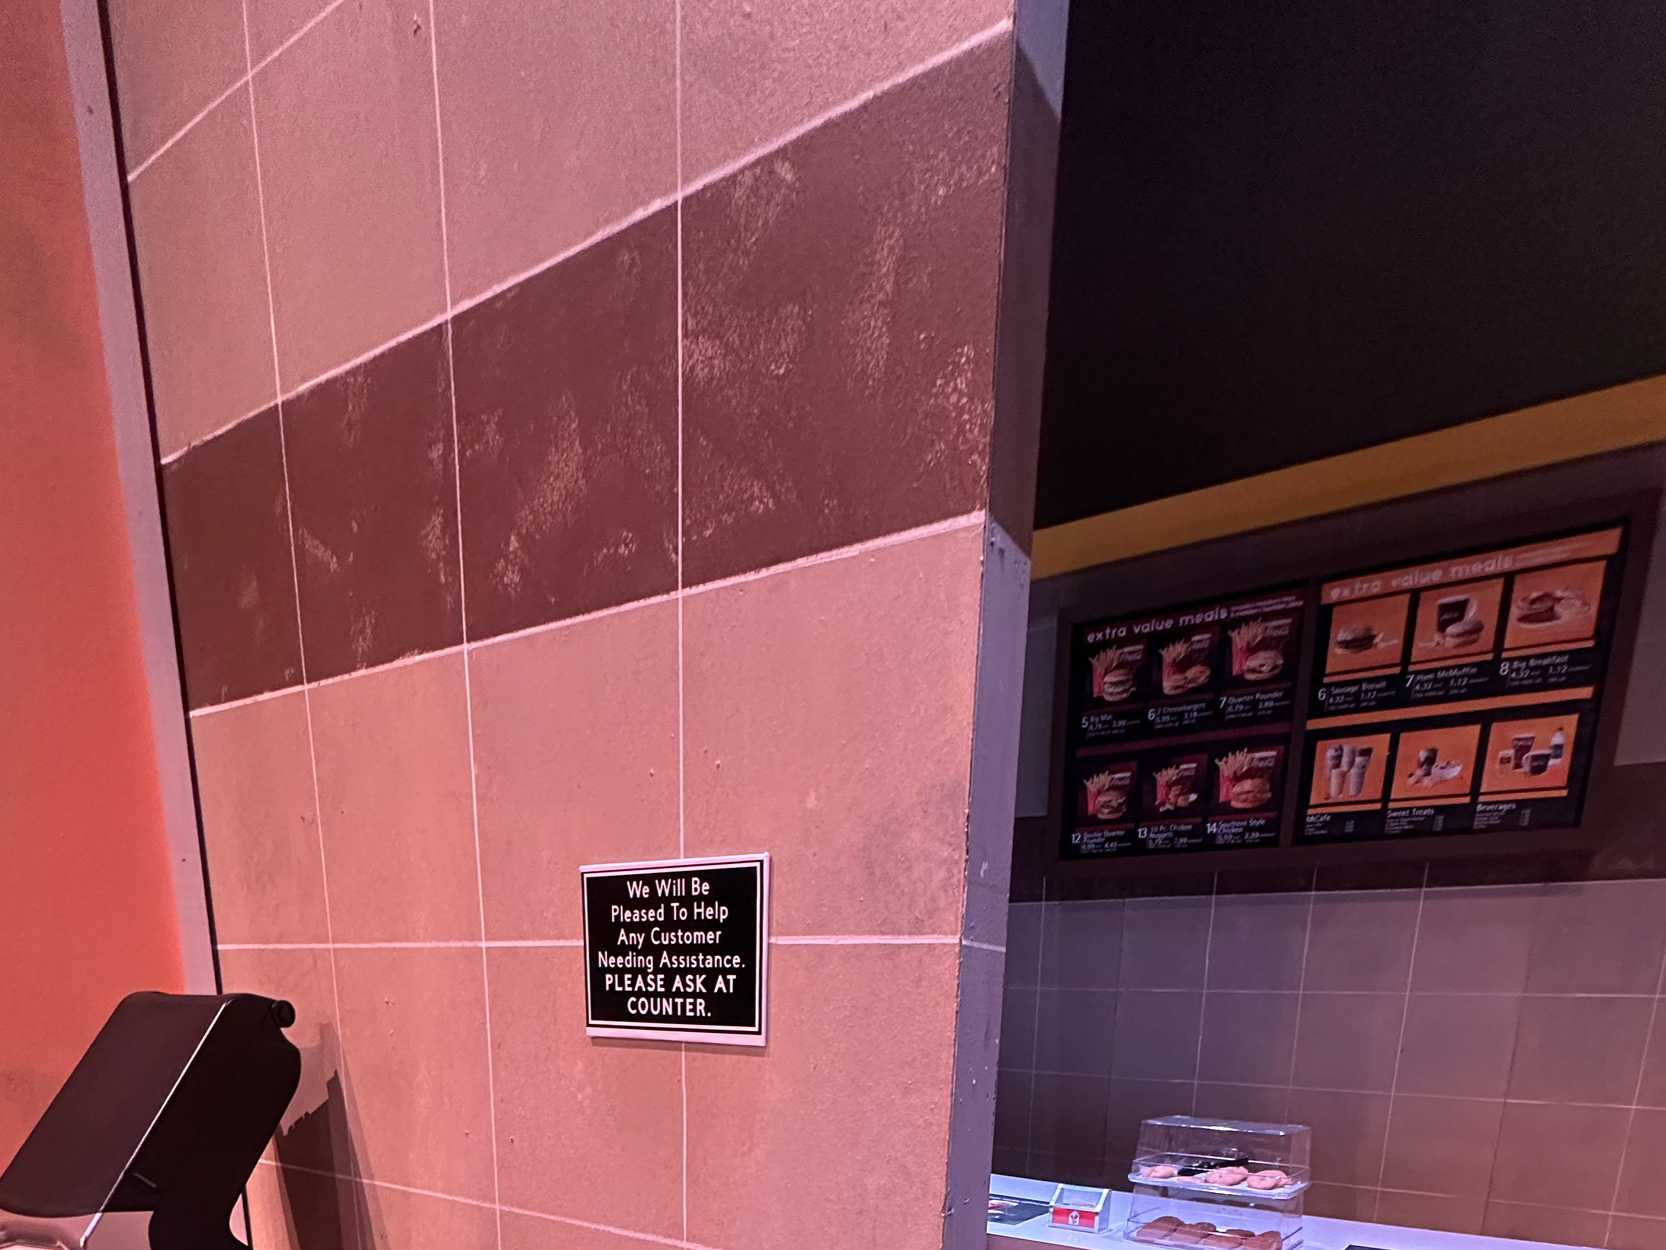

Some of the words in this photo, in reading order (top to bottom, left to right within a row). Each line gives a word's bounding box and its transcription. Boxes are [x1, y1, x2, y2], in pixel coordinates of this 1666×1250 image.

[1330, 579, 1381, 599] extra
[1391, 568, 1443, 588] value
[1450, 554, 1514, 578] meals
[1086, 627, 1127, 644] extra
[1132, 618, 1174, 635] value
[1178, 606, 1228, 627] meals
[1498, 661, 1510, 676] 8
[1405, 674, 1415, 688] 7
[1317, 688, 1327, 701] 6
[1219, 696, 1227, 709] 7
[1147, 708, 1156, 721] 6
[1081, 716, 1089, 729] 5
[1386, 808, 1410, 819] Sweet
[1411, 807, 1435, 816] Treats
[1476, 802, 1517, 812] Beverages
[1137, 827, 1148, 839] 13
[1205, 822, 1218, 834] 14
[1071, 833, 1082, 844] 12
[627, 880, 650, 899] We
[655, 878, 686, 897] Will
[691, 877, 710, 896] Be
[611, 903, 665, 923] Pleased
[670, 902, 688, 921] To
[693, 901, 729, 923] Help
[617, 928, 645, 949] Any
[650, 927, 722, 945] Customer
[598, 951, 654, 972] Needing
[659, 950, 746, 968] Assistance.
[605, 974, 665, 992] PLEASE
[672, 974, 707, 993] ASK
[713, 974, 737, 993] AT
[627, 997, 712, 1017] COUNTER.
